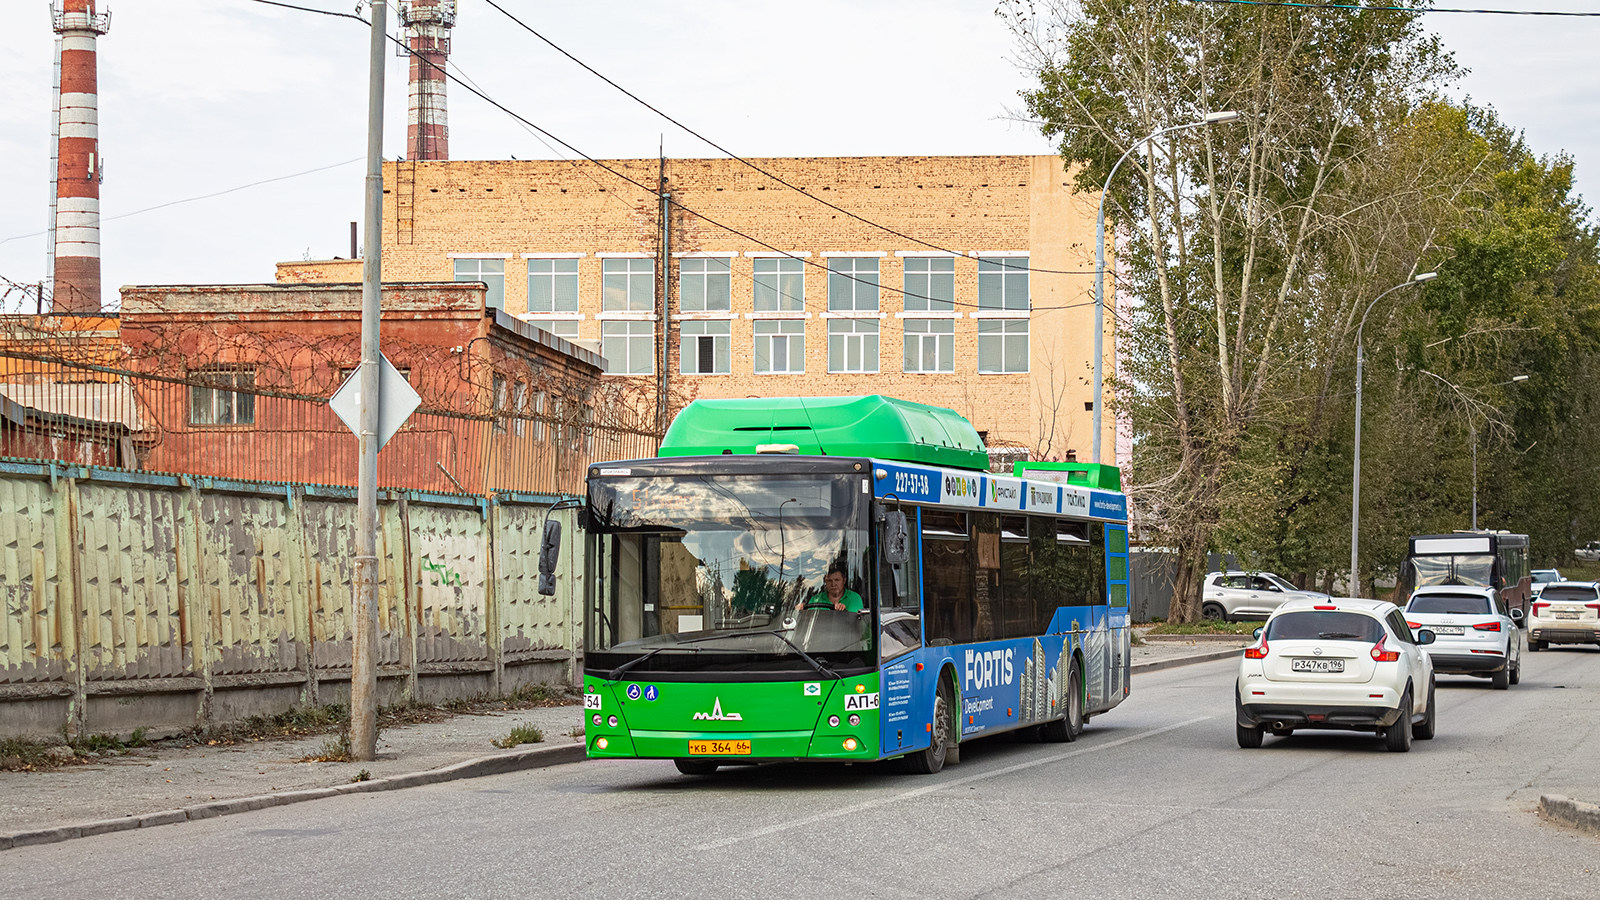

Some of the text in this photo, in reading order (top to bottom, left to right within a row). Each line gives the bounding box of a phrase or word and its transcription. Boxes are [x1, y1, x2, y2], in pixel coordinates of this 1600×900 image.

[895, 471, 929, 495] 227-37-38
[965, 648, 1013, 691] FORTIS
[965, 696, 994, 716] Development
[711, 742, 731, 753] 364
[736, 741, 747, 750] 66
